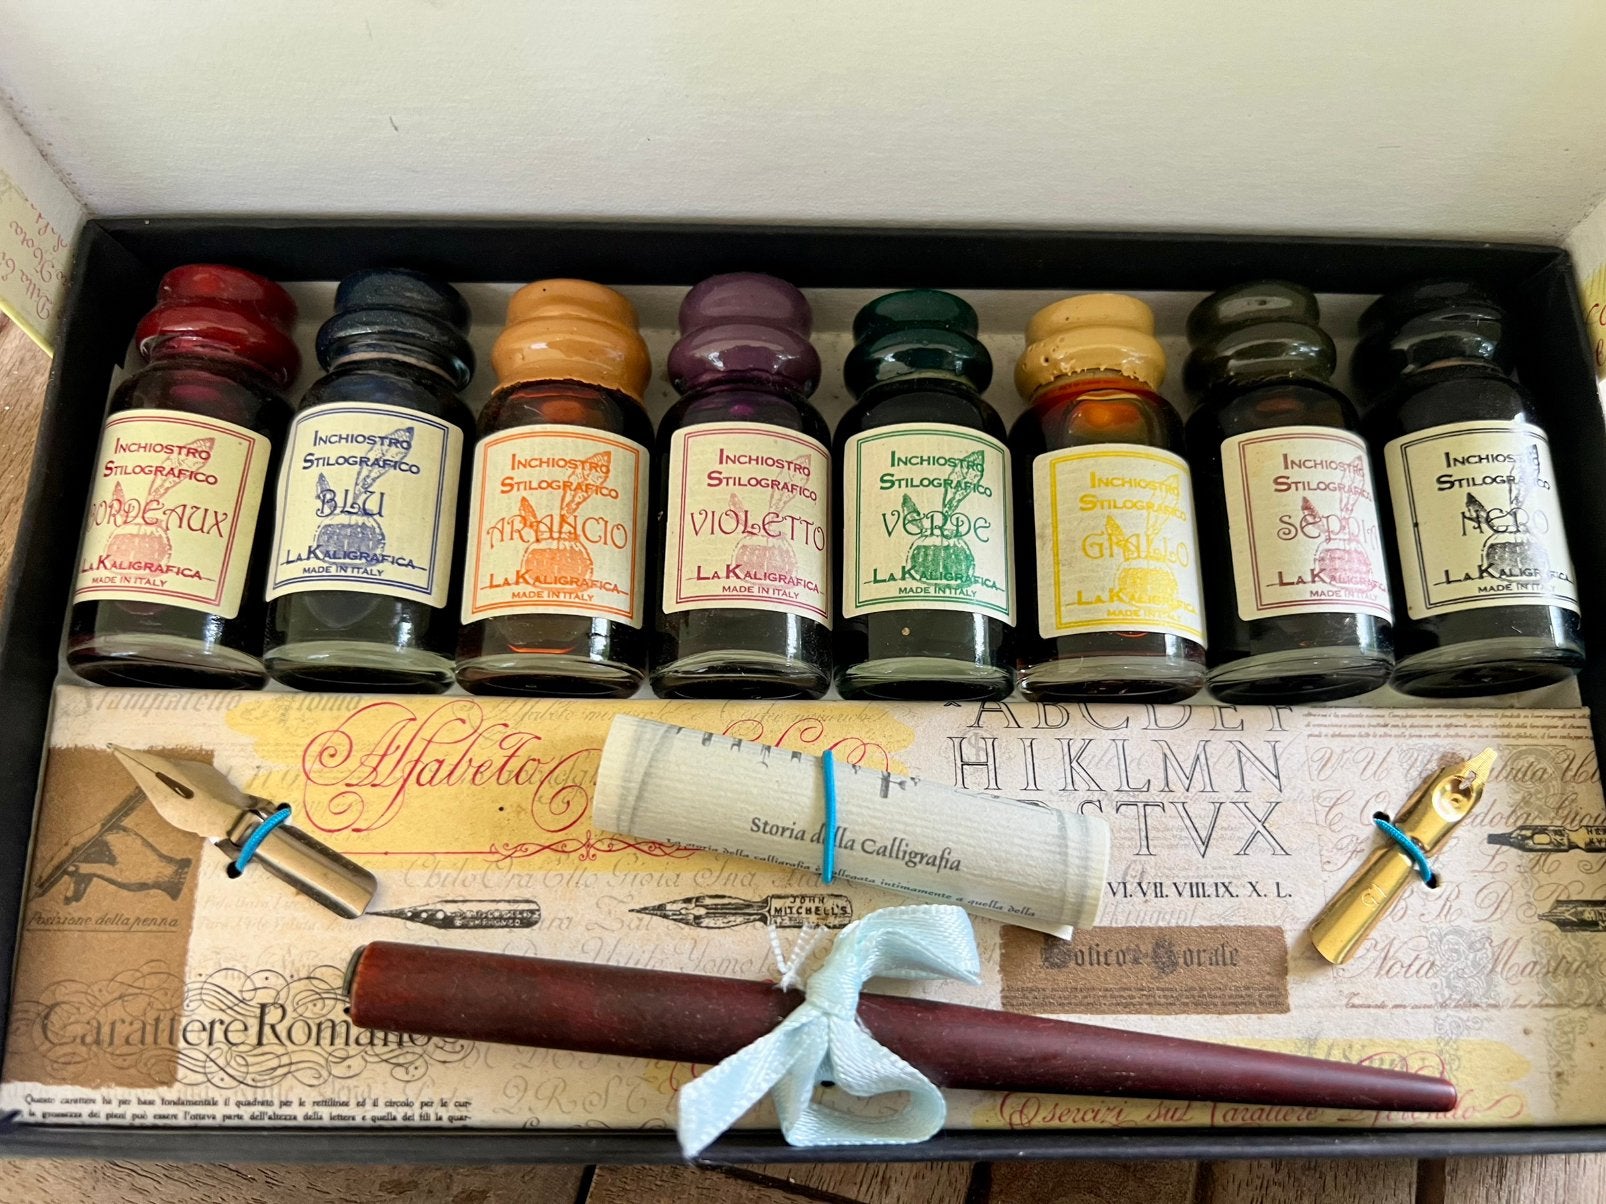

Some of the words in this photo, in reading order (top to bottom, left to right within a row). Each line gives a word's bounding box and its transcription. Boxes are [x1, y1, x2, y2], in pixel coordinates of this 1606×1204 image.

[114, 437, 212, 461] INCHIOSTRO
[312, 430, 412, 450] INCHIOSTRO
[302, 452, 421, 475] STILOGRAFICO
[511, 453, 611, 475] INCHIOSTRO
[719, 447, 811, 477] INCHIOSTRO
[890, 450, 984, 473] INCHIOSTRO
[1445, 451, 1540, 468] INCHIOS
[103, 459, 219, 486] STILOGRAFICO
[500, 476, 619, 500] STILOGRAFICO
[706, 470, 817, 501] STILOGRAFICO
[880, 473, 993, 498] STILOGRAFICO
[315, 488, 386, 518] BLU
[486, 514, 628, 550] ARANCIO
[690, 509, 825, 552] VIOLETTO
[881, 510, 991, 543] VERDE
[303, 566, 333, 575] MADE
[349, 566, 385, 577] ITALY
[725, 562, 820, 593] KALIGRAFICA
[511, 590, 545, 599] MADE
[722, 585, 755, 594] MADE
[757, 586, 769, 595] IN
[771, 587, 800, 600] ITALY
[898, 586, 931, 595] MADE
[947, 586, 977, 598] ITALY
[1309, 590, 1342, 598] MADE
[1478, 584, 1512, 593] MADE
[302, 700, 582, 832] Alfabeto
[750, 816, 806, 842] Storia
[810, 823, 856, 851] dlla
[860, 837, 962, 873] Calligrafia
[831, 868, 875, 884] ollegata
[95, 912, 130, 926] della
[41, 1002, 250, 1047] Carattere
